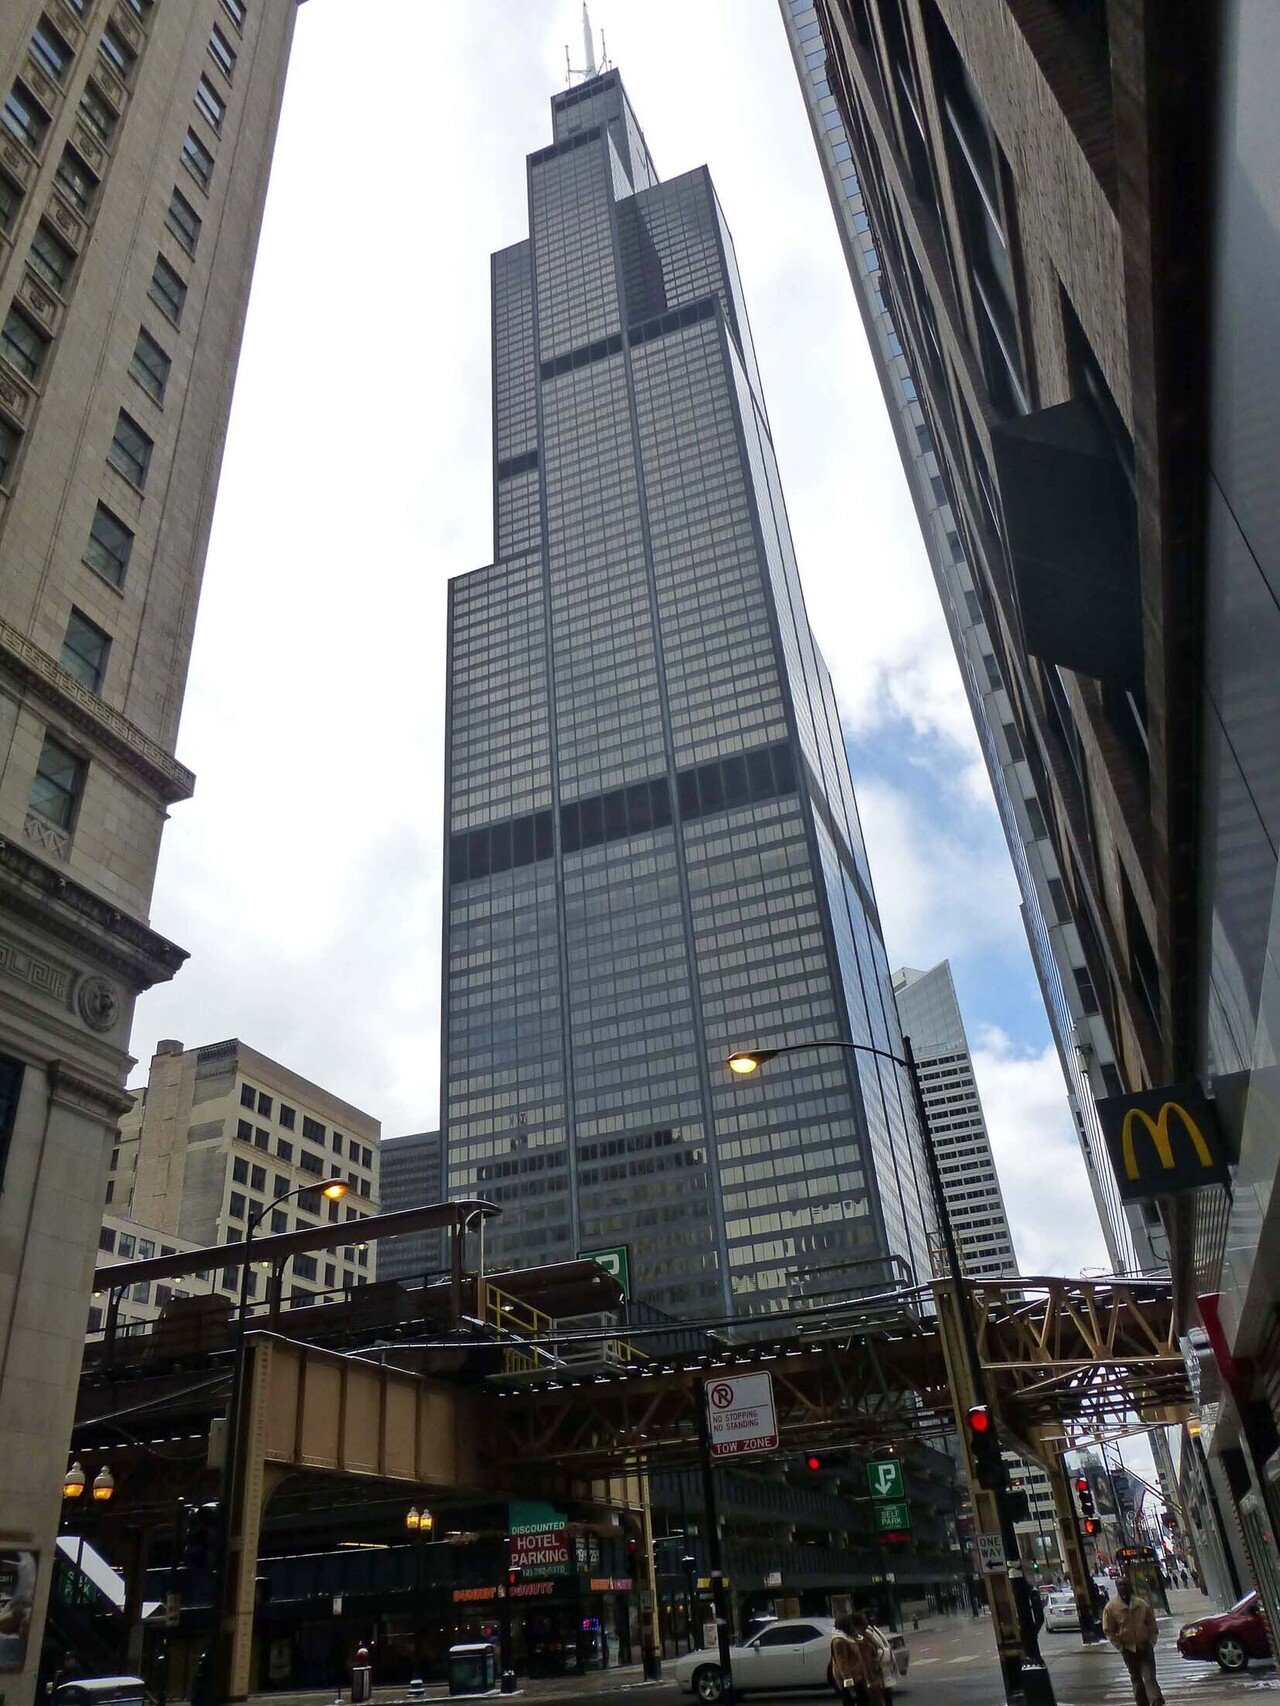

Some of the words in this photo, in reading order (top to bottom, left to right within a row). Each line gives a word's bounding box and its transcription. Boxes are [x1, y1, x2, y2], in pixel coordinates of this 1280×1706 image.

[713, 1415, 723, 1423] NO
[726, 1410, 758, 1421] STOPPING
[713, 1424, 724, 1432] NO
[727, 1419, 759, 1430] STANDING
[716, 1442, 738, 1454] TOW
[743, 1437, 772, 1450] ZONE
[881, 1510, 900, 1519] SELF
[511, 1521, 565, 1535] DISCOUNTED
[881, 1517, 902, 1526] PARK
[517, 1534, 560, 1550] HOTEL
[980, 1537, 1000, 1547] ONE
[511, 1548, 569, 1566] PARKING
[981, 1548, 1002, 1557] WAY
[509, 1581, 554, 1597] DONUTS
